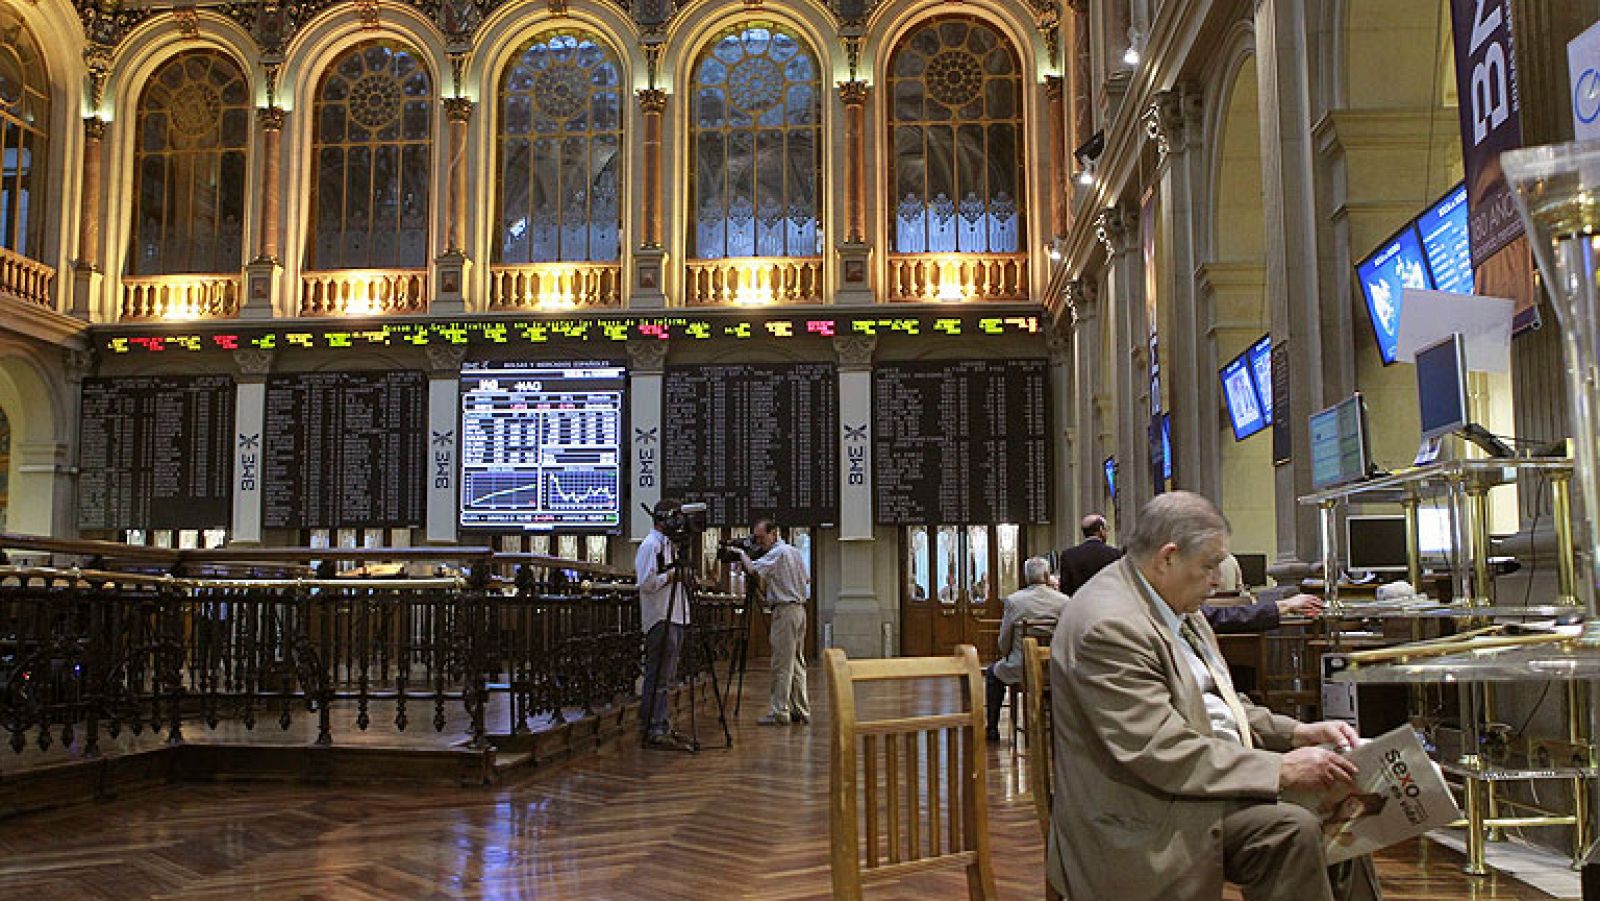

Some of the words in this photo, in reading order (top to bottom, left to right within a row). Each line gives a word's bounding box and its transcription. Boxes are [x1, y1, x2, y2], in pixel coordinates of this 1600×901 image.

[241, 454, 255, 491] BME
[435, 451, 450, 489] BME
[639, 448, 654, 487] BME
[848, 446, 863, 485] BME
[1384, 748, 1420, 797] sexo
